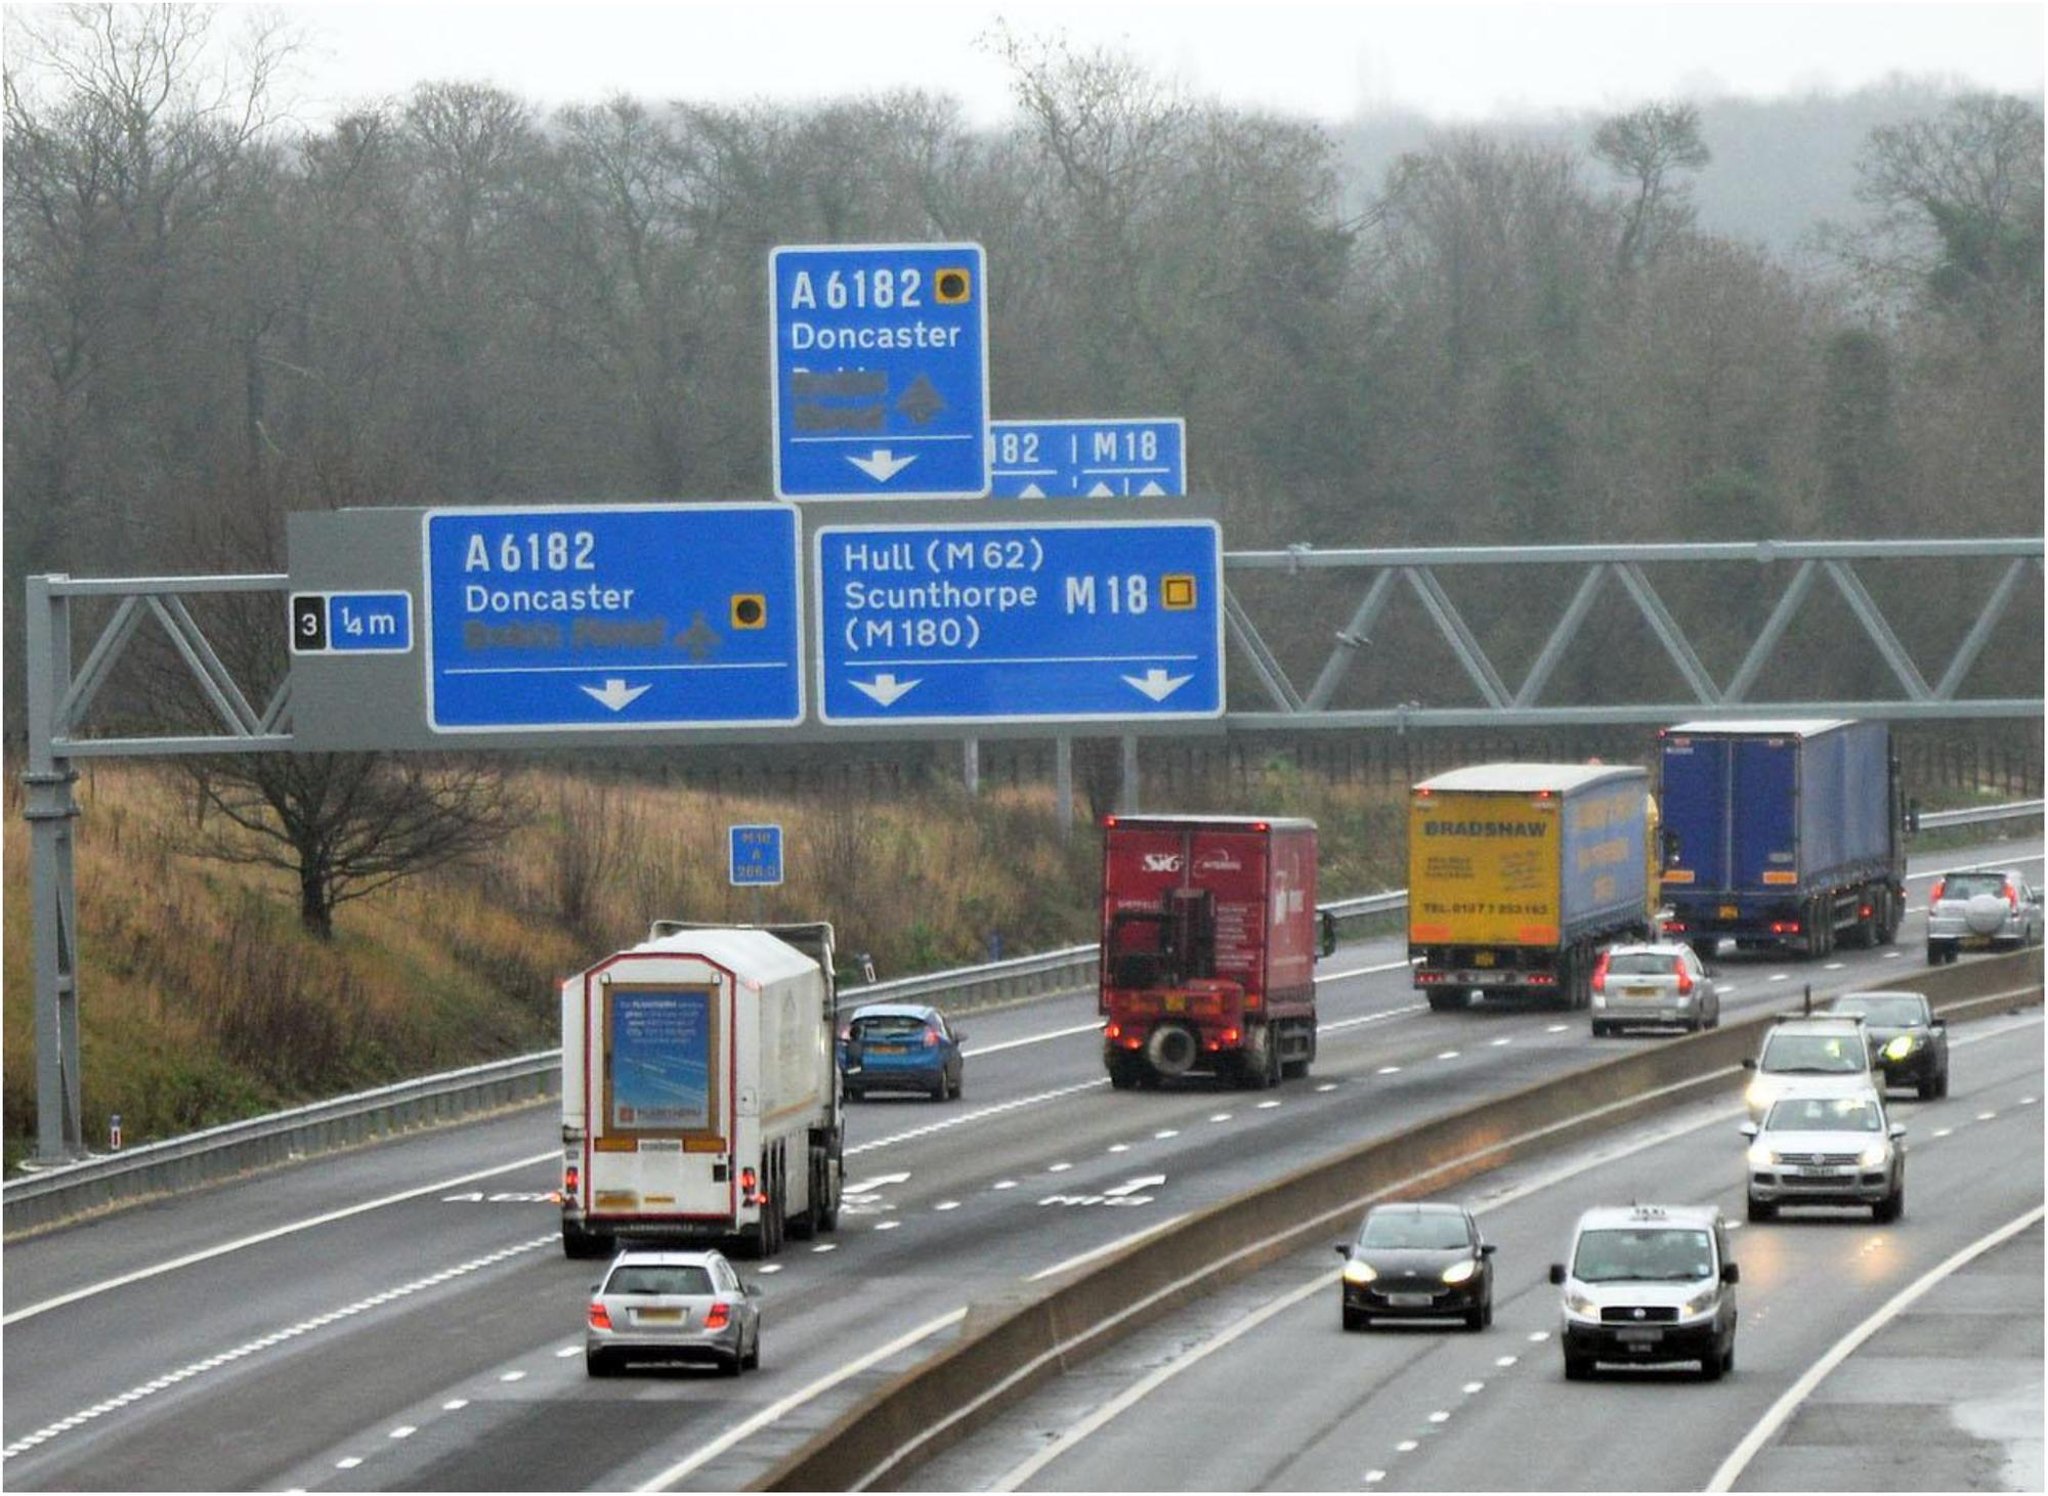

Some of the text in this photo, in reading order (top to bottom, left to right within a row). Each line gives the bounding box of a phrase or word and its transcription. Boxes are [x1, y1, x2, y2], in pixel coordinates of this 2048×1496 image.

[792, 321, 962, 350] Doncaster
[845, 543, 914, 571] Hull
[466, 584, 635, 613] Doncaster
[845, 581, 1038, 612] Scunthorpe
[302, 613, 318, 637] 3
[1424, 821, 1547, 838] BRADSHAW
